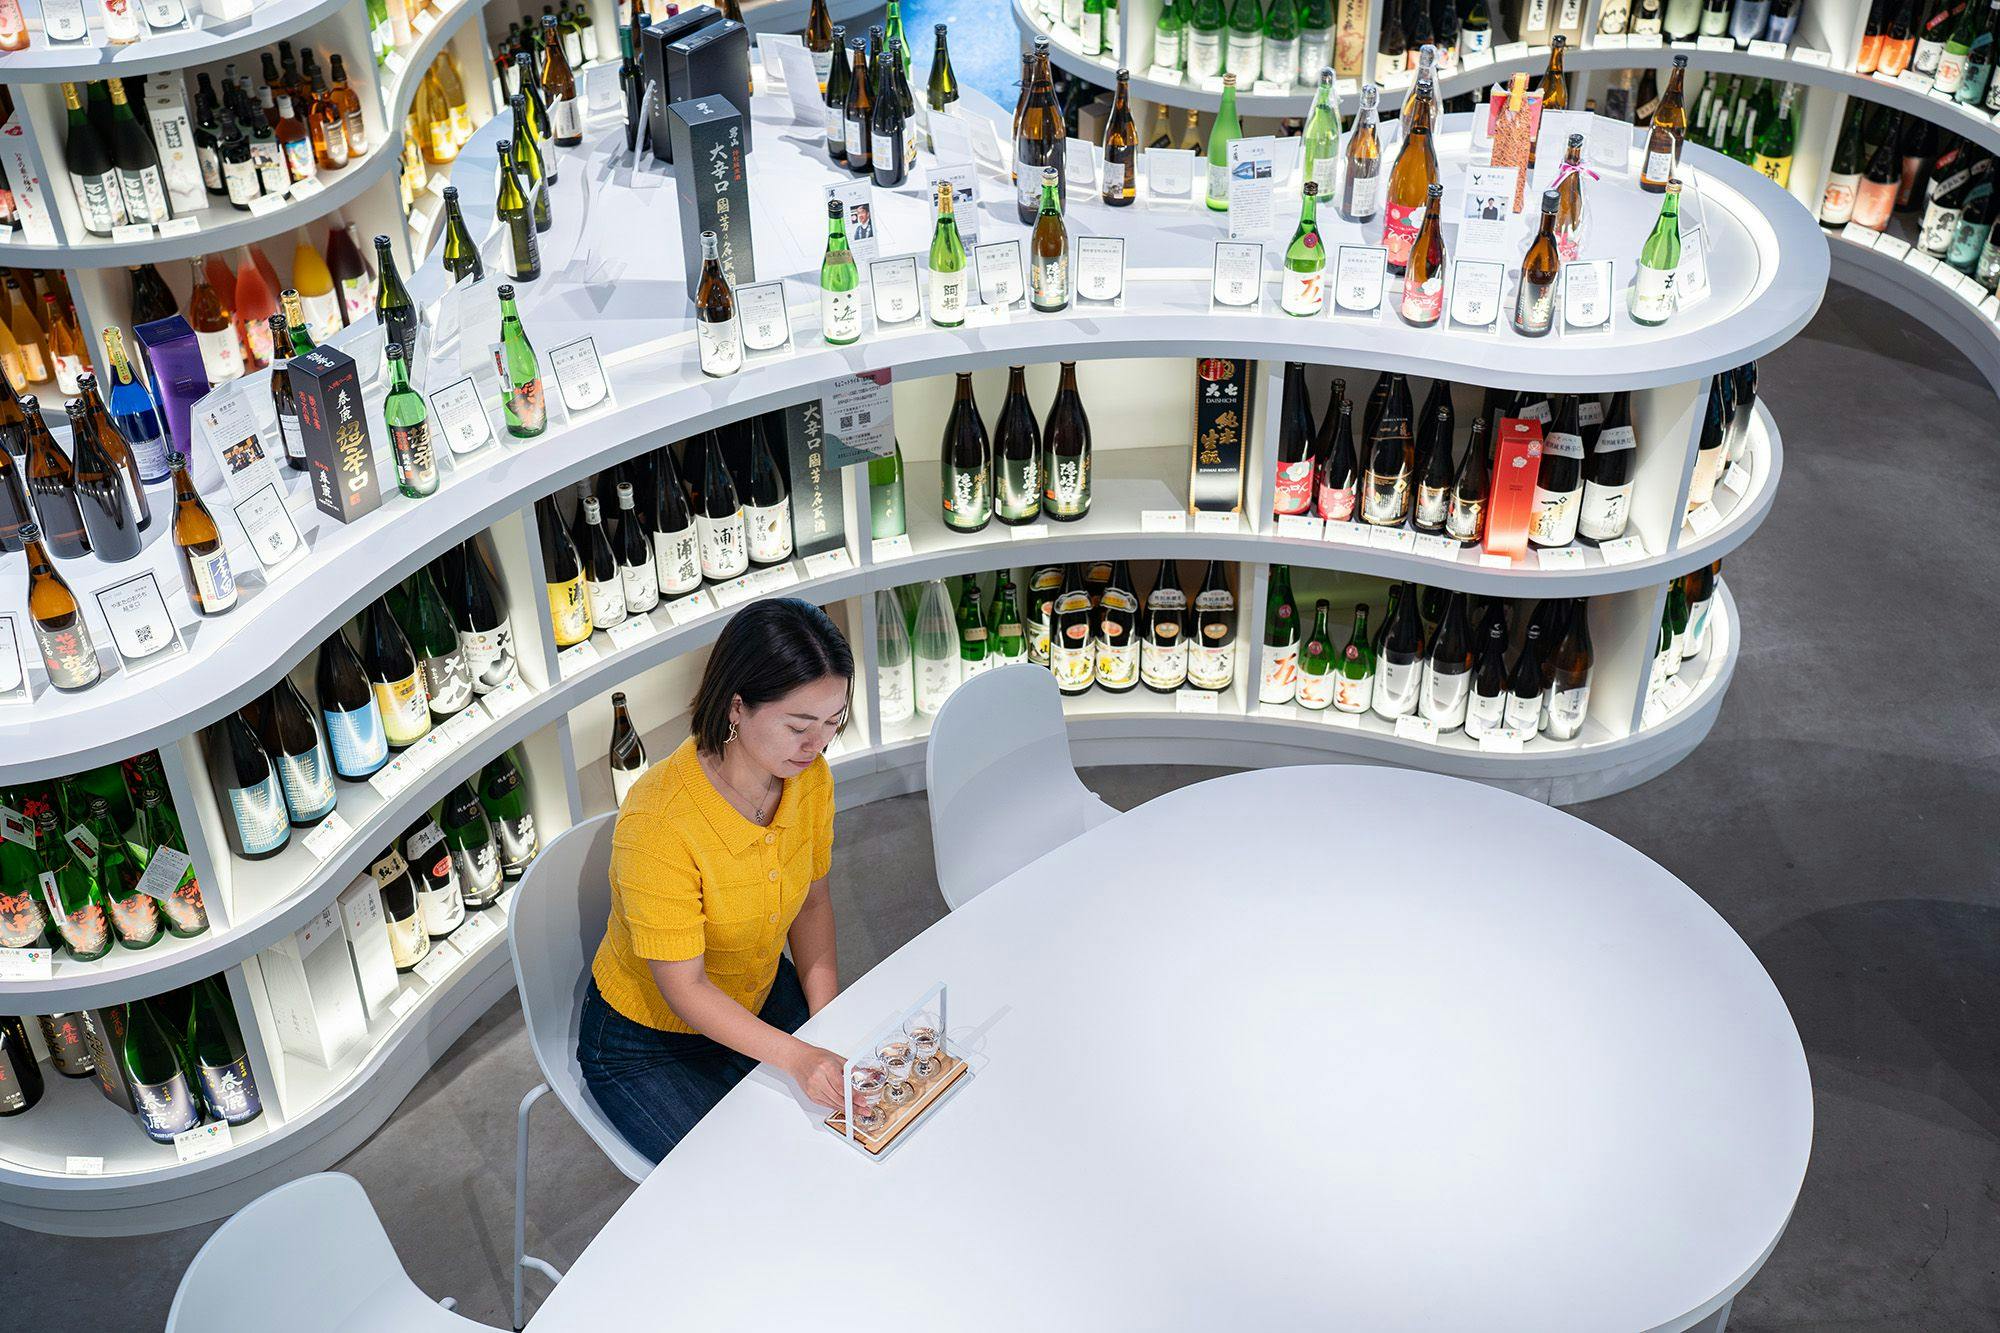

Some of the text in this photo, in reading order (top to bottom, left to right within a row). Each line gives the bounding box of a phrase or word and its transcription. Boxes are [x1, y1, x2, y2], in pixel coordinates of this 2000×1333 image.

[709, 142, 730, 194] 大辛口
[336, 389, 353, 424] 春鹿
[803, 404, 821, 450] 大辛口
[336, 420, 369, 492] 超辛口
[677, 537, 699, 582] 浦霞
[141, 1091, 171, 1130] 春鹿
[220, 1070, 248, 1112] 春鹿
